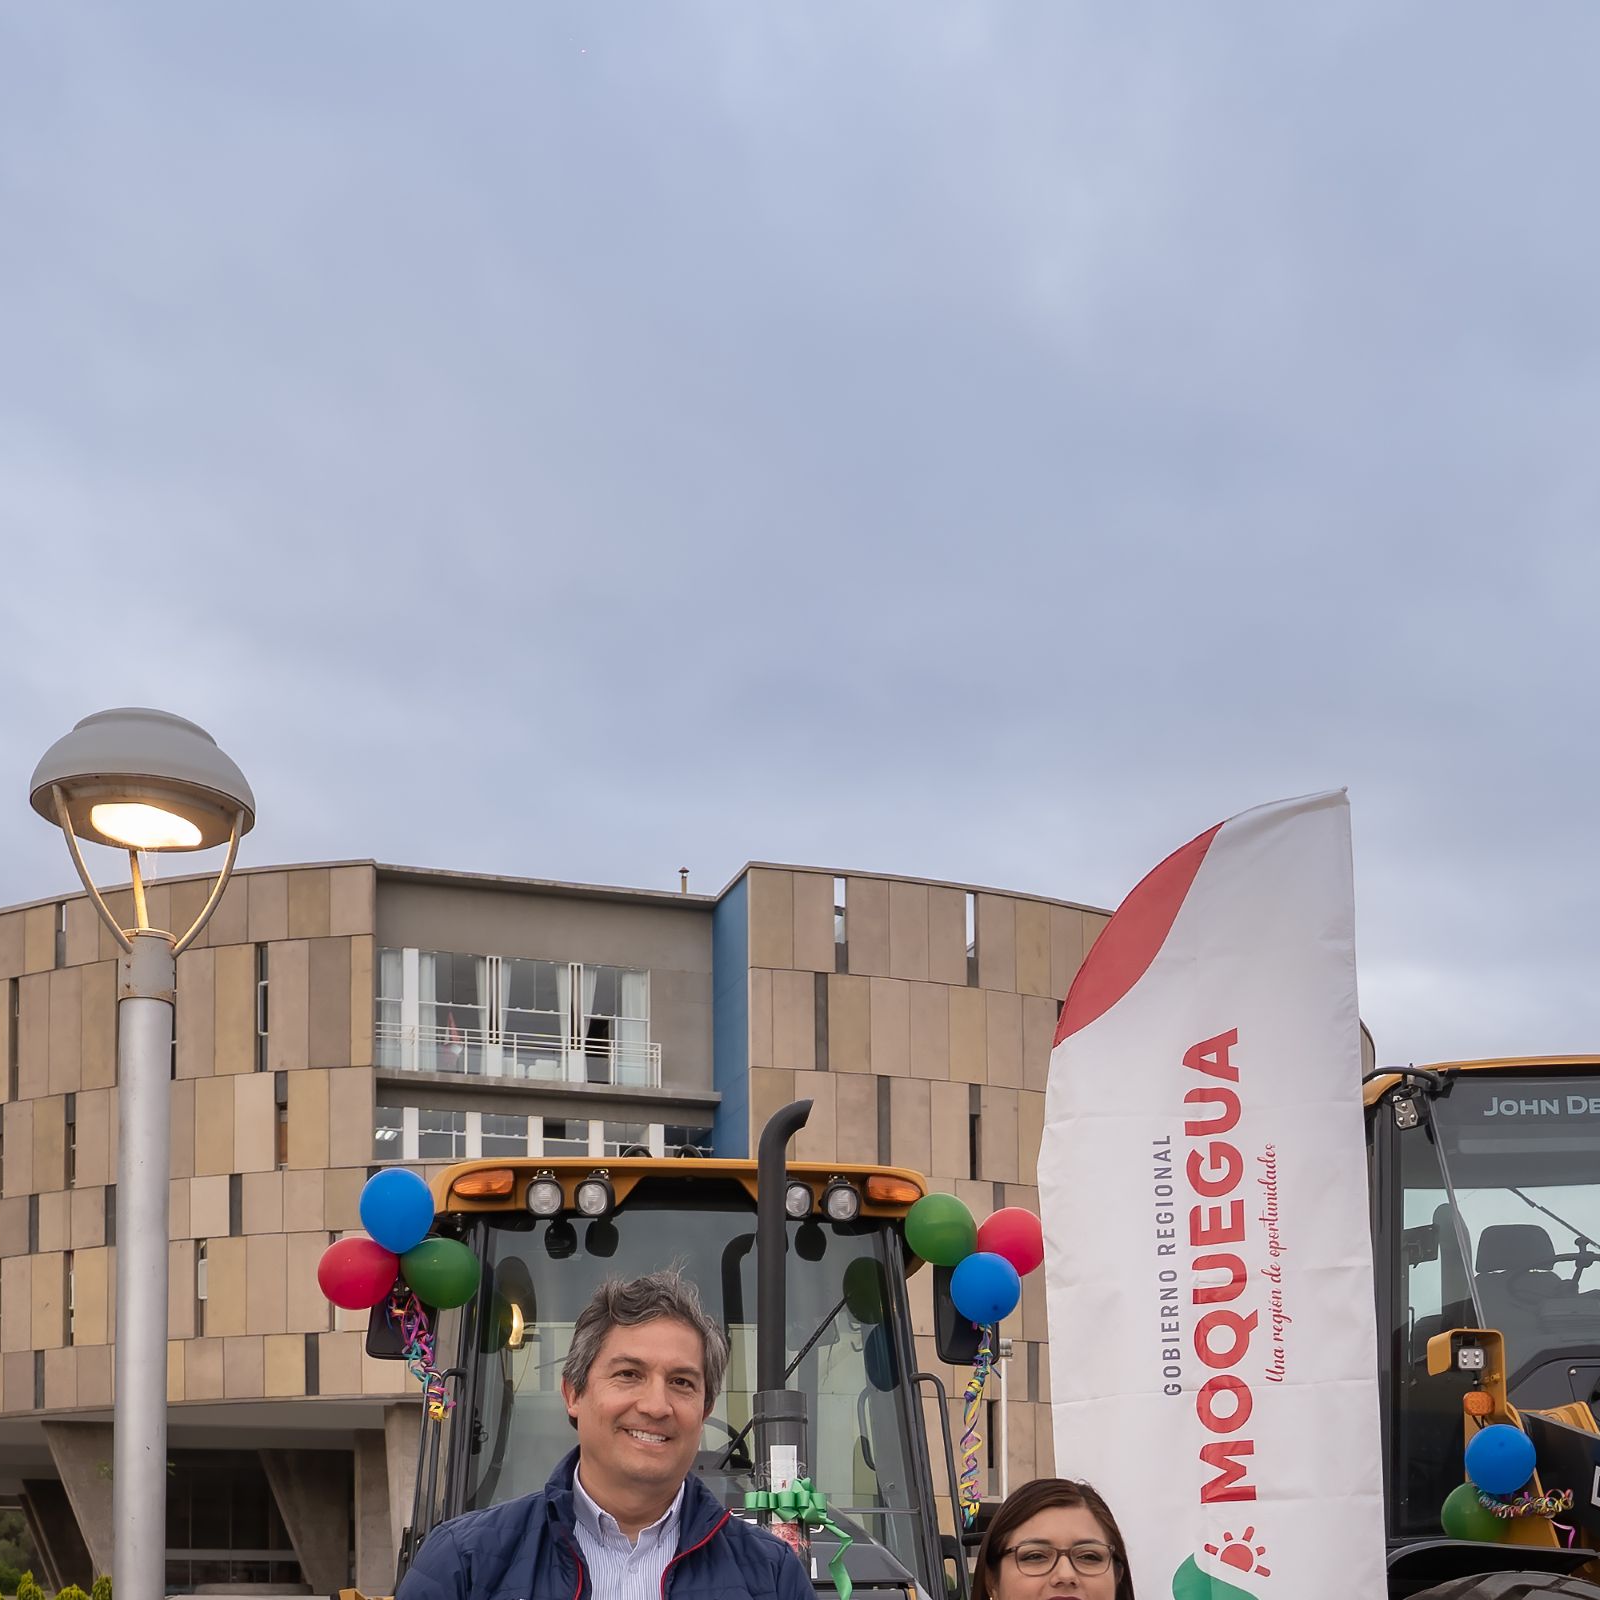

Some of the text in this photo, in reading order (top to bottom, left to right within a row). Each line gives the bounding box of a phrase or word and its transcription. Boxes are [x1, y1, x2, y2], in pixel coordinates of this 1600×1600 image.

[1483, 1096, 1560, 1116] JOHN
[1153, 1135, 1182, 1396] GOBIERNO REGIONAL
[1182, 1027, 1258, 1504] MOQUEGUA
[1257, 1143, 1293, 1383] Una región de oportunidades
